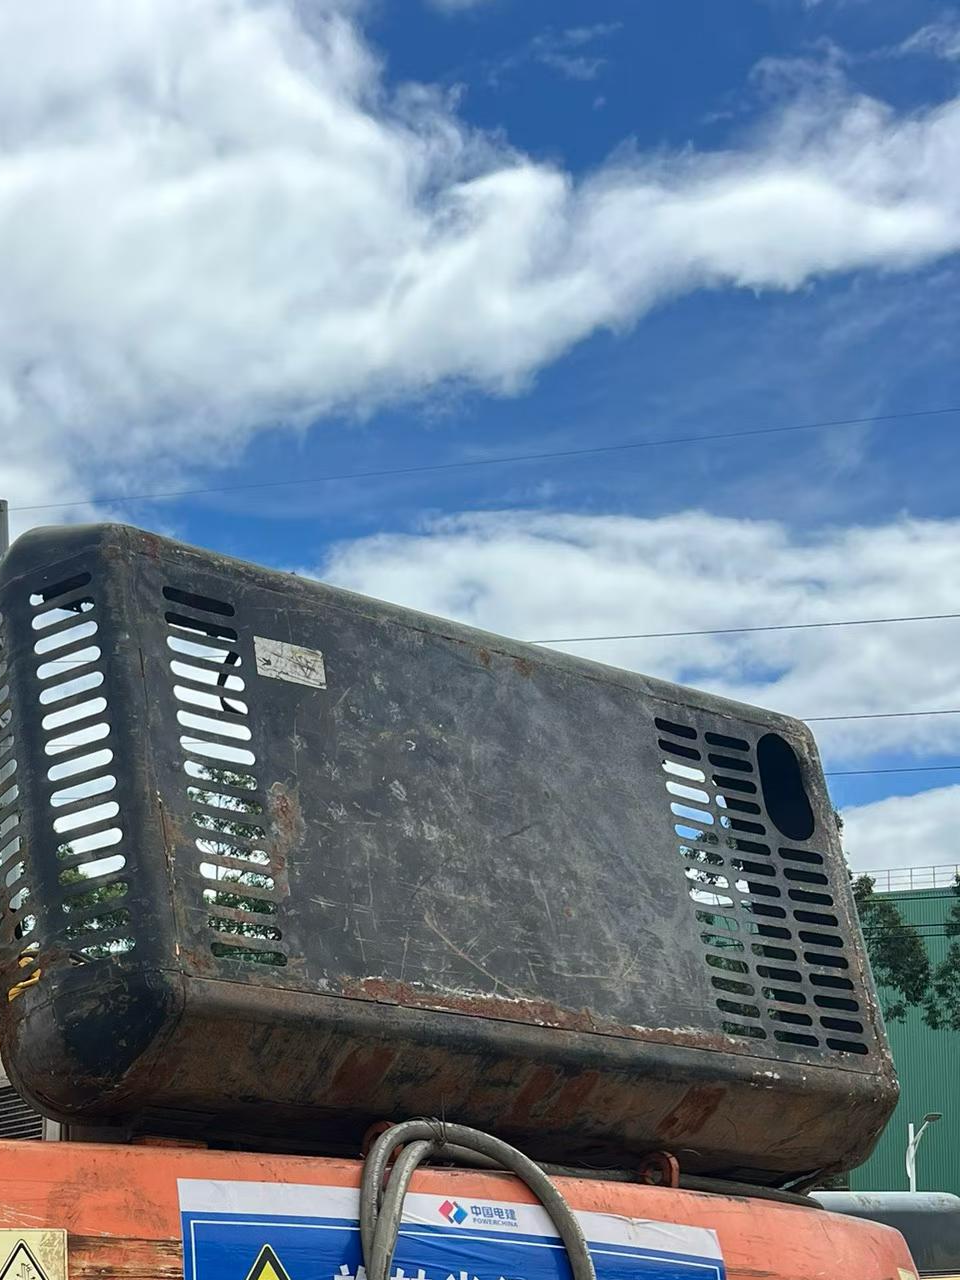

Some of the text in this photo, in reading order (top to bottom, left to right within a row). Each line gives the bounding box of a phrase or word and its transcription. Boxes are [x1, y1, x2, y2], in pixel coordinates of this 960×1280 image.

[470, 1205, 517, 1220] 中国电建
[473, 1218, 518, 1228] POWERCHINA
